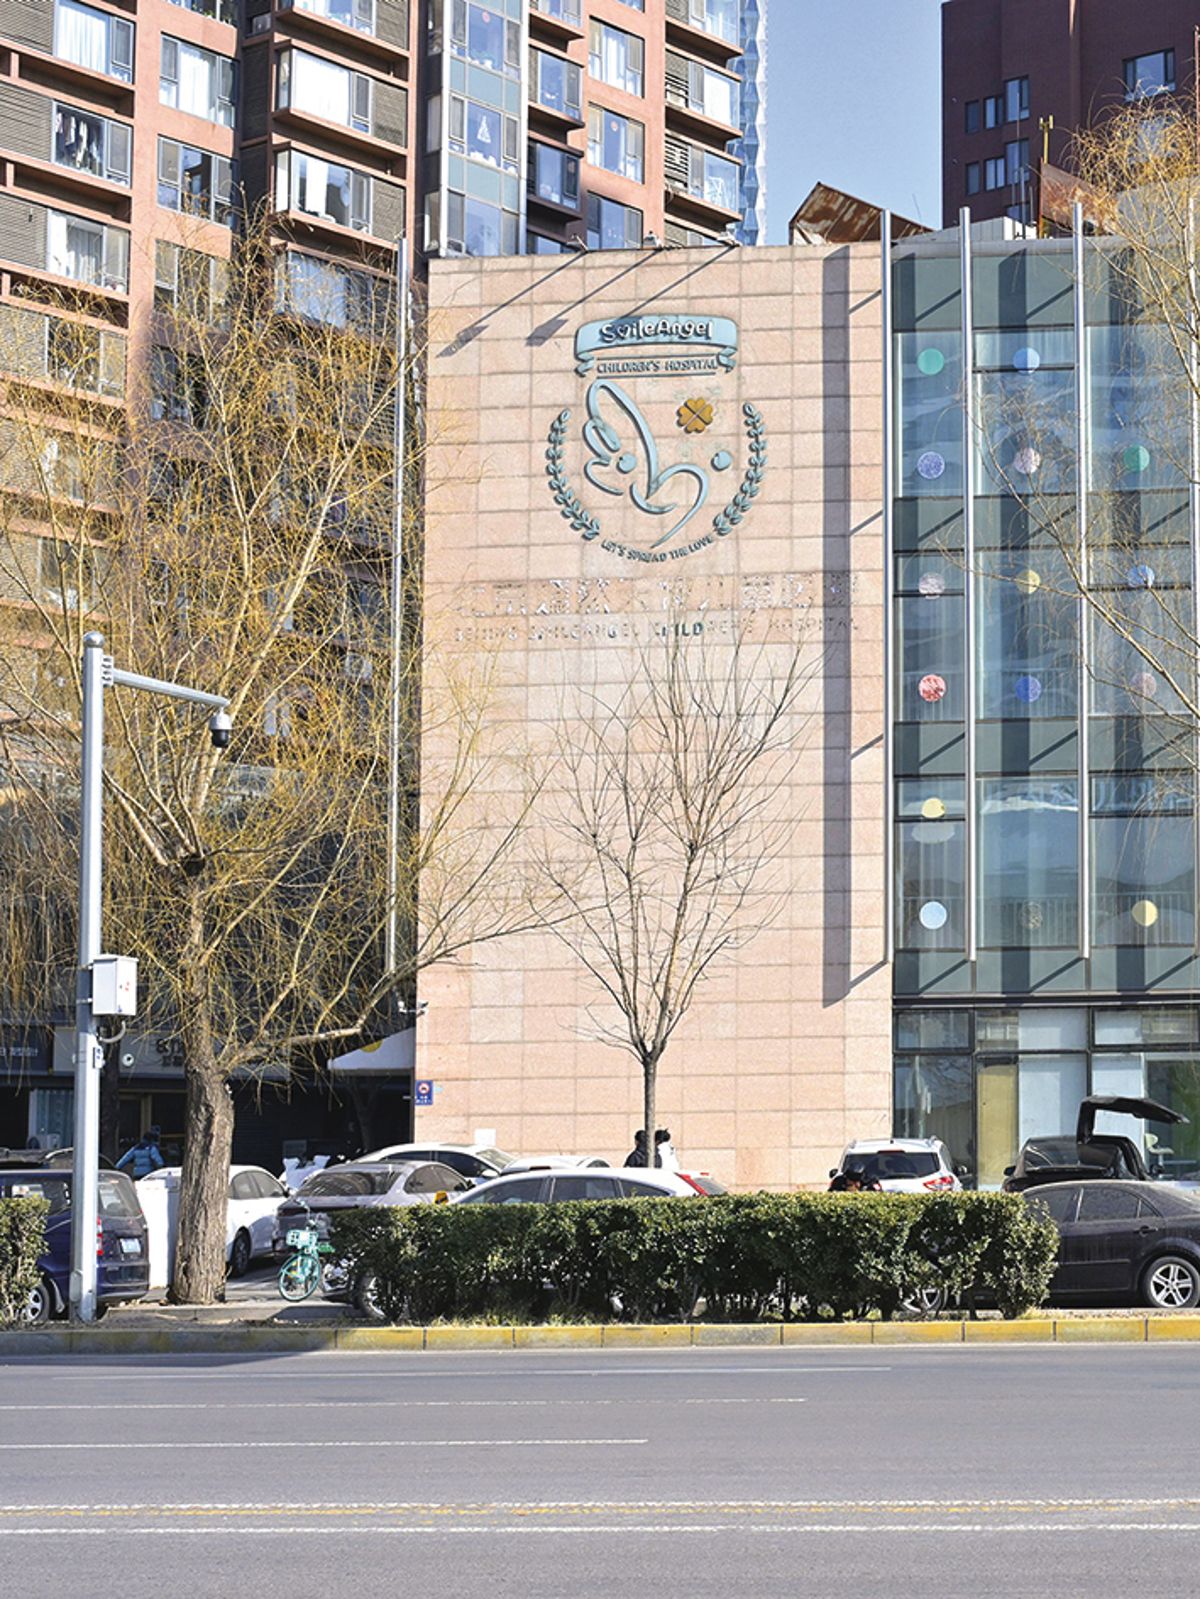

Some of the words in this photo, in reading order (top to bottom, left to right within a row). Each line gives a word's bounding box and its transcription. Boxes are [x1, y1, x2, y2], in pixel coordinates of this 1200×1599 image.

[597, 359, 661, 375] CHILDREN'S
[664, 358, 719, 373] HOSPITAL
[600, 539, 627, 557] LET'S
[627, 549, 668, 563] SPREAD
[668, 547, 688, 560] THE
[688, 535, 714, 553] LOVE
